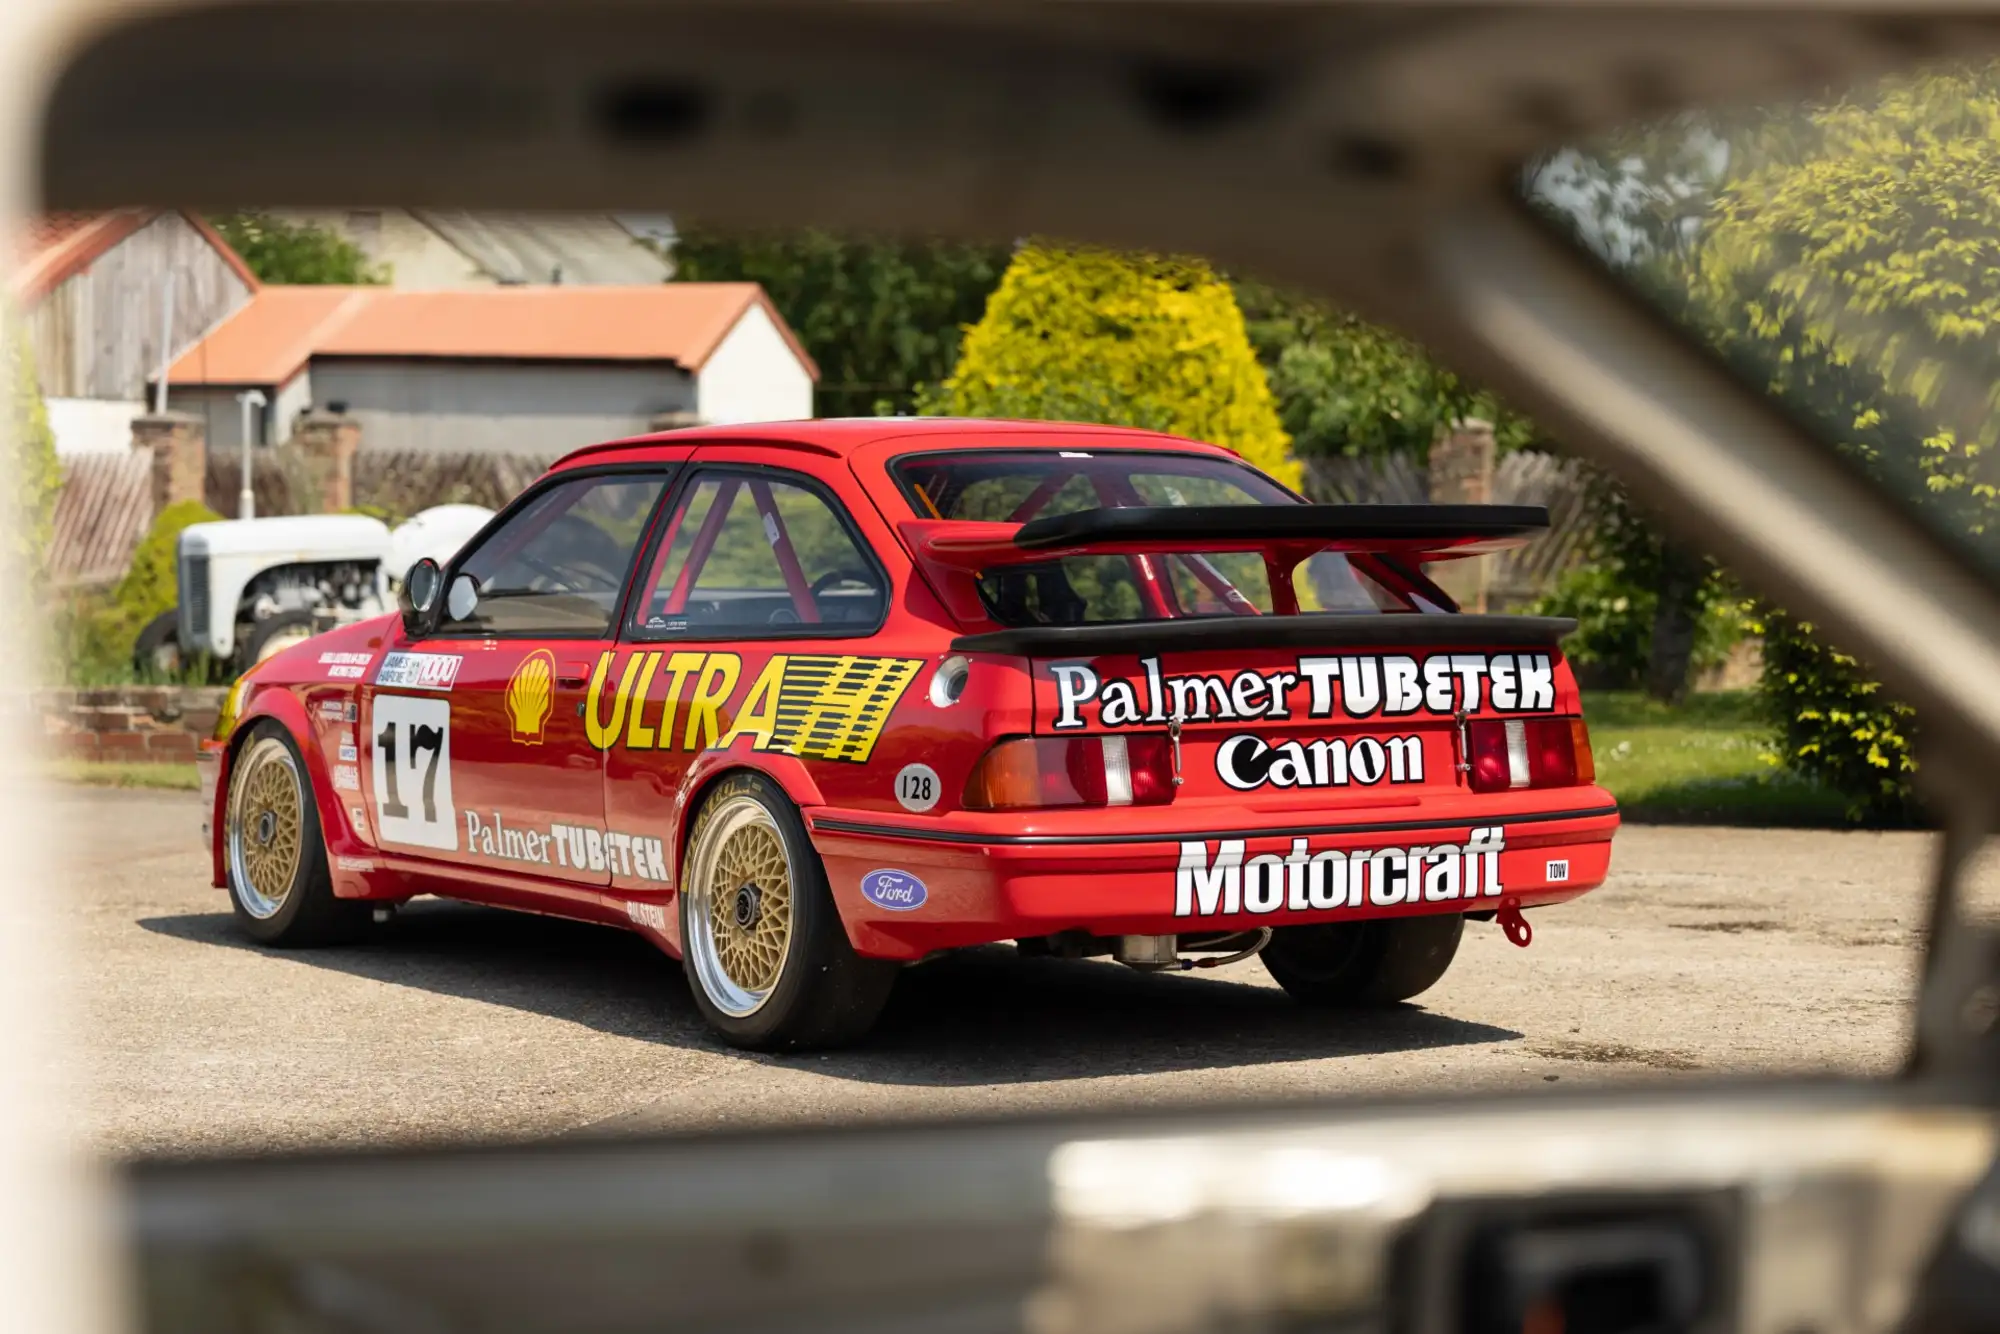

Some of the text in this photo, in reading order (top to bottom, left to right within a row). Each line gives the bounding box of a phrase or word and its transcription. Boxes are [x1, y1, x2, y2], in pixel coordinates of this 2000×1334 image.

[379, 669, 405, 683] HARDIE
[384, 655, 411, 669] JAMES
[420, 656, 457, 682] 1000
[584, 651, 789, 751] ULTRA
[1050, 654, 1554, 728] Palmer TUBETEK
[378, 722, 443, 822] 17
[1216, 734, 1423, 789] Canon
[902, 775, 931, 801] 128
[464, 810, 551, 864] Palmer
[550, 823, 670, 882] TUBETEK
[875, 875, 915, 904] Ford
[1175, 826, 1505, 917] Motorcraft
[1548, 863, 1567, 880] TOW
